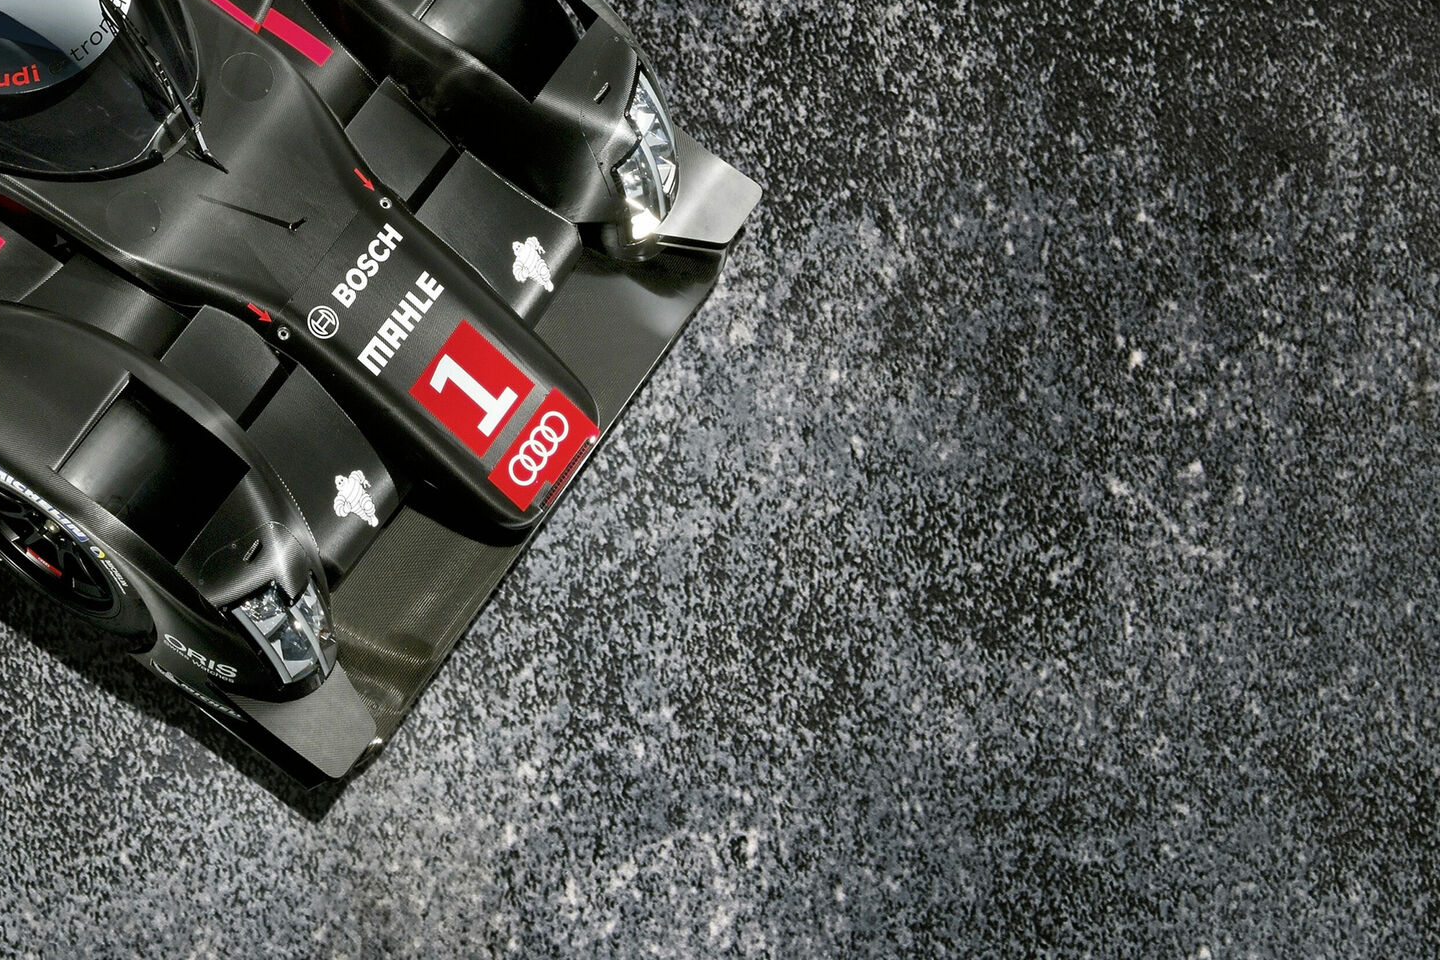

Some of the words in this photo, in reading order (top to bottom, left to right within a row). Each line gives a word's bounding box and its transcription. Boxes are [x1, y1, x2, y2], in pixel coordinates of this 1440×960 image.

[331, 223, 404, 308] BOSCH
[357, 270, 445, 376] MAHLE
[429, 353, 518, 437] 1
[163, 633, 238, 678] ORIS
[191, 658, 235, 684] Watches
